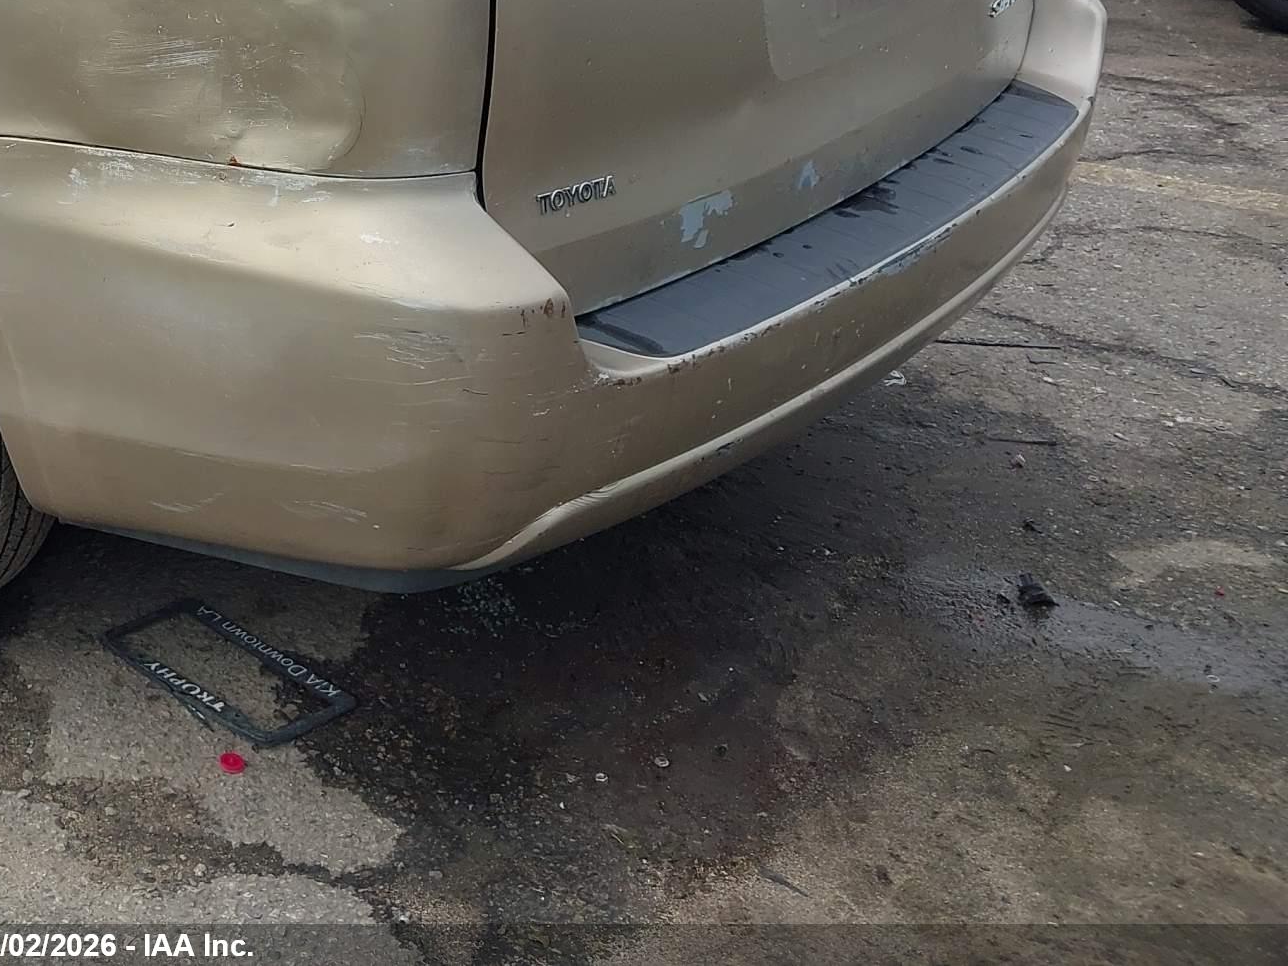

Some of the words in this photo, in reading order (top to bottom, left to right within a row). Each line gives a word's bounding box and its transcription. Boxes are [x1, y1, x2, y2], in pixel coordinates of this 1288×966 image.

[536, 175, 616, 215] TOYOTA
[197, 605, 222, 622] LA
[143, 662, 225, 712] TROPHY
[306, 673, 341, 697] KIA
